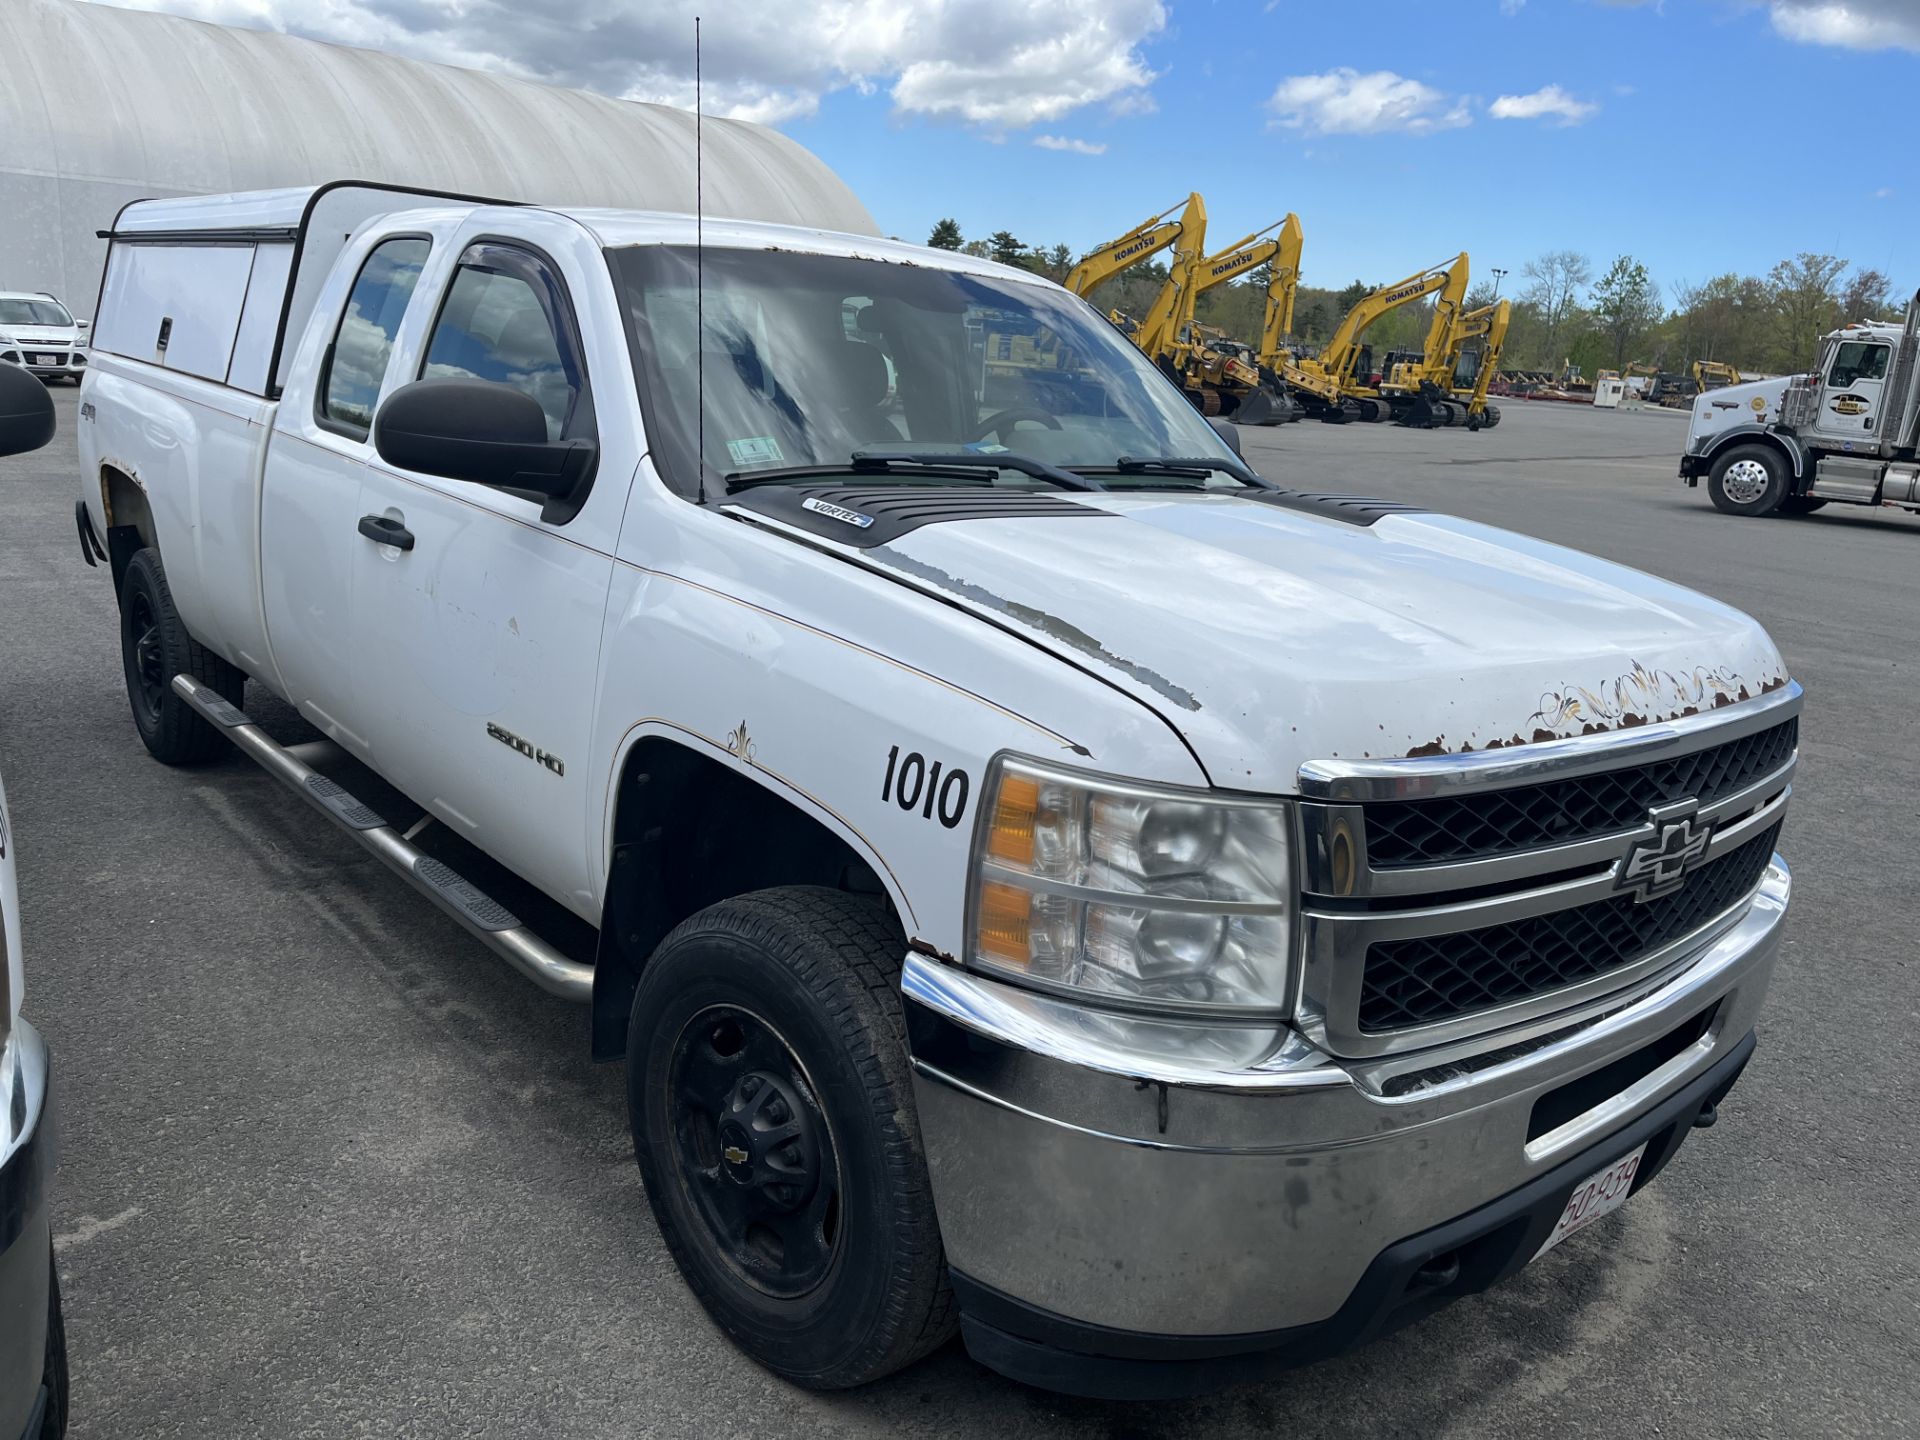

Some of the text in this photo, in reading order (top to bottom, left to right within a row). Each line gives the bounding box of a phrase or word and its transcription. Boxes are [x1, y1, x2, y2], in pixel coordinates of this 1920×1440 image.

[1114, 236, 1155, 262] KOMATSU
[1212, 252, 1253, 276] KOMATSU
[1385, 284, 1425, 304] KOMATSU
[812, 501, 863, 523] VORTEC
[882, 745, 970, 829] 1010
